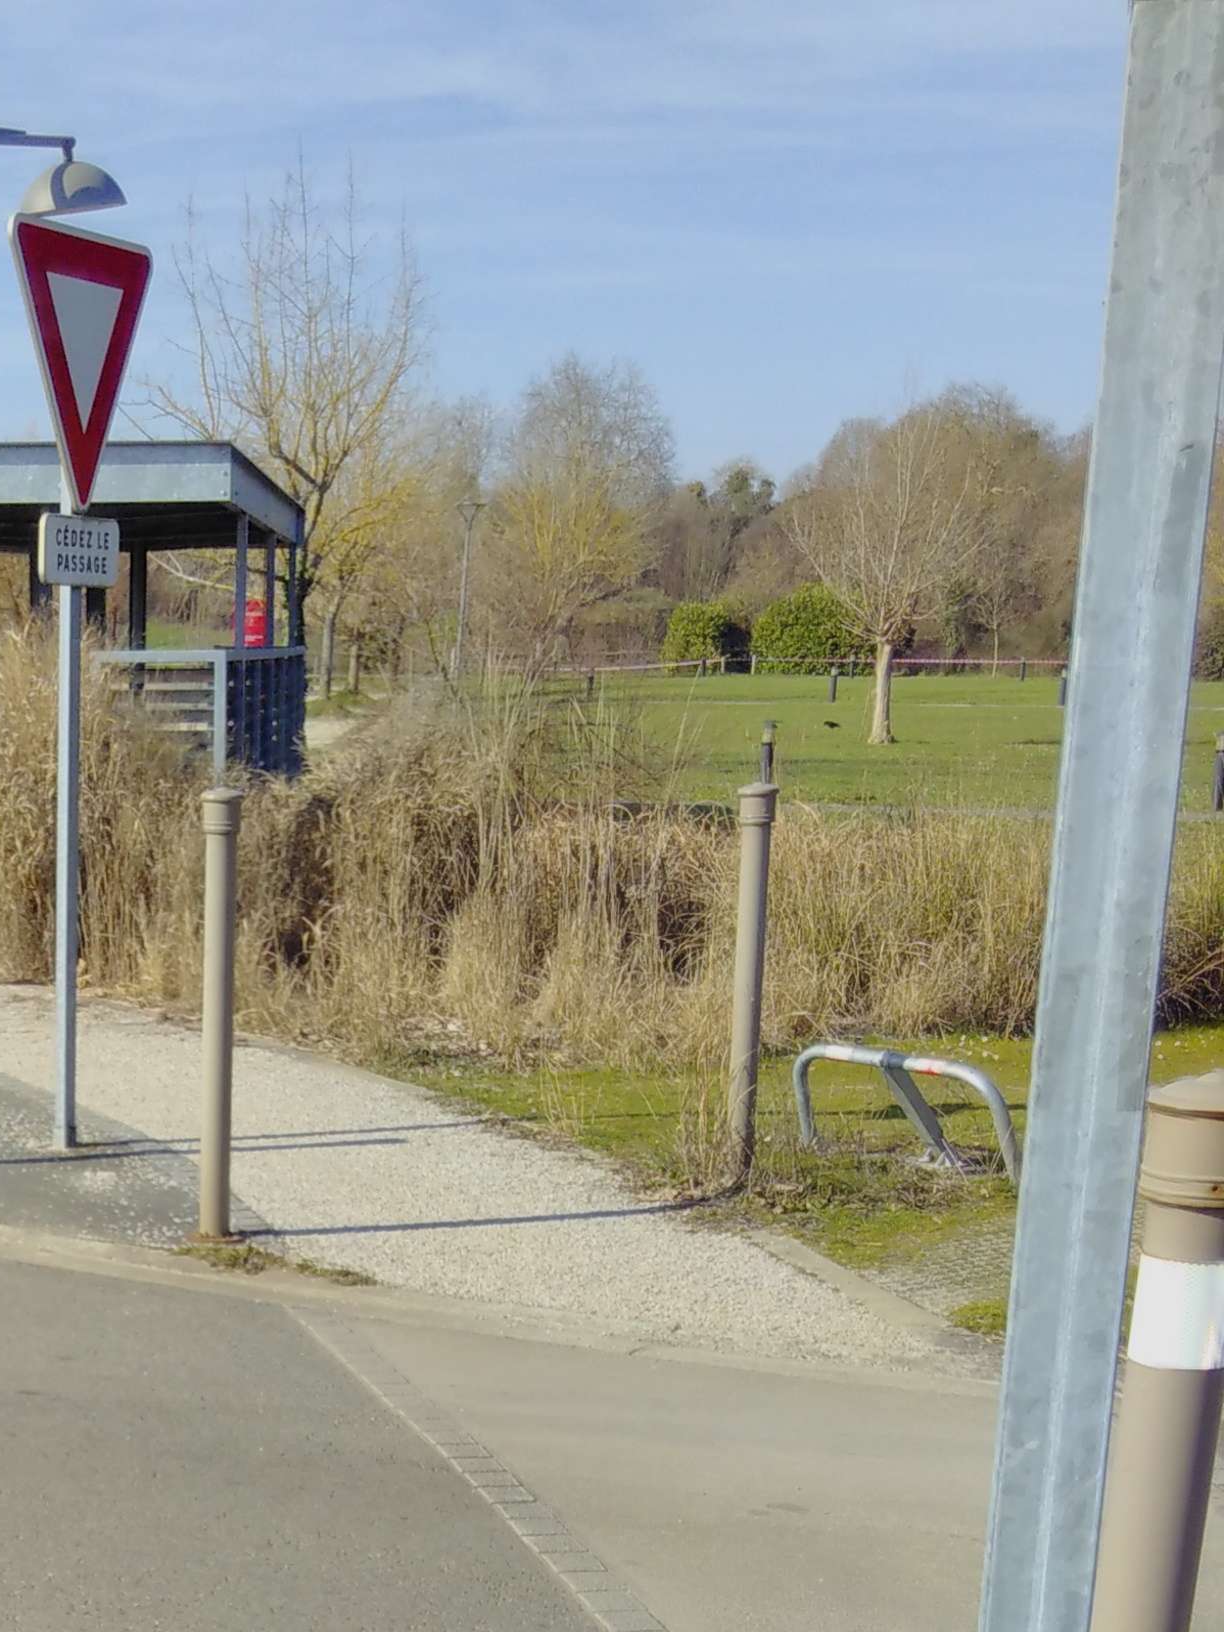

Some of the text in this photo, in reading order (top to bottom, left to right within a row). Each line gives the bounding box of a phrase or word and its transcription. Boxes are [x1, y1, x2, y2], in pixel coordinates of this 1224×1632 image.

[56, 525, 110, 550] CÉDEZ LE
[57, 553, 107, 574] PASSAGE
